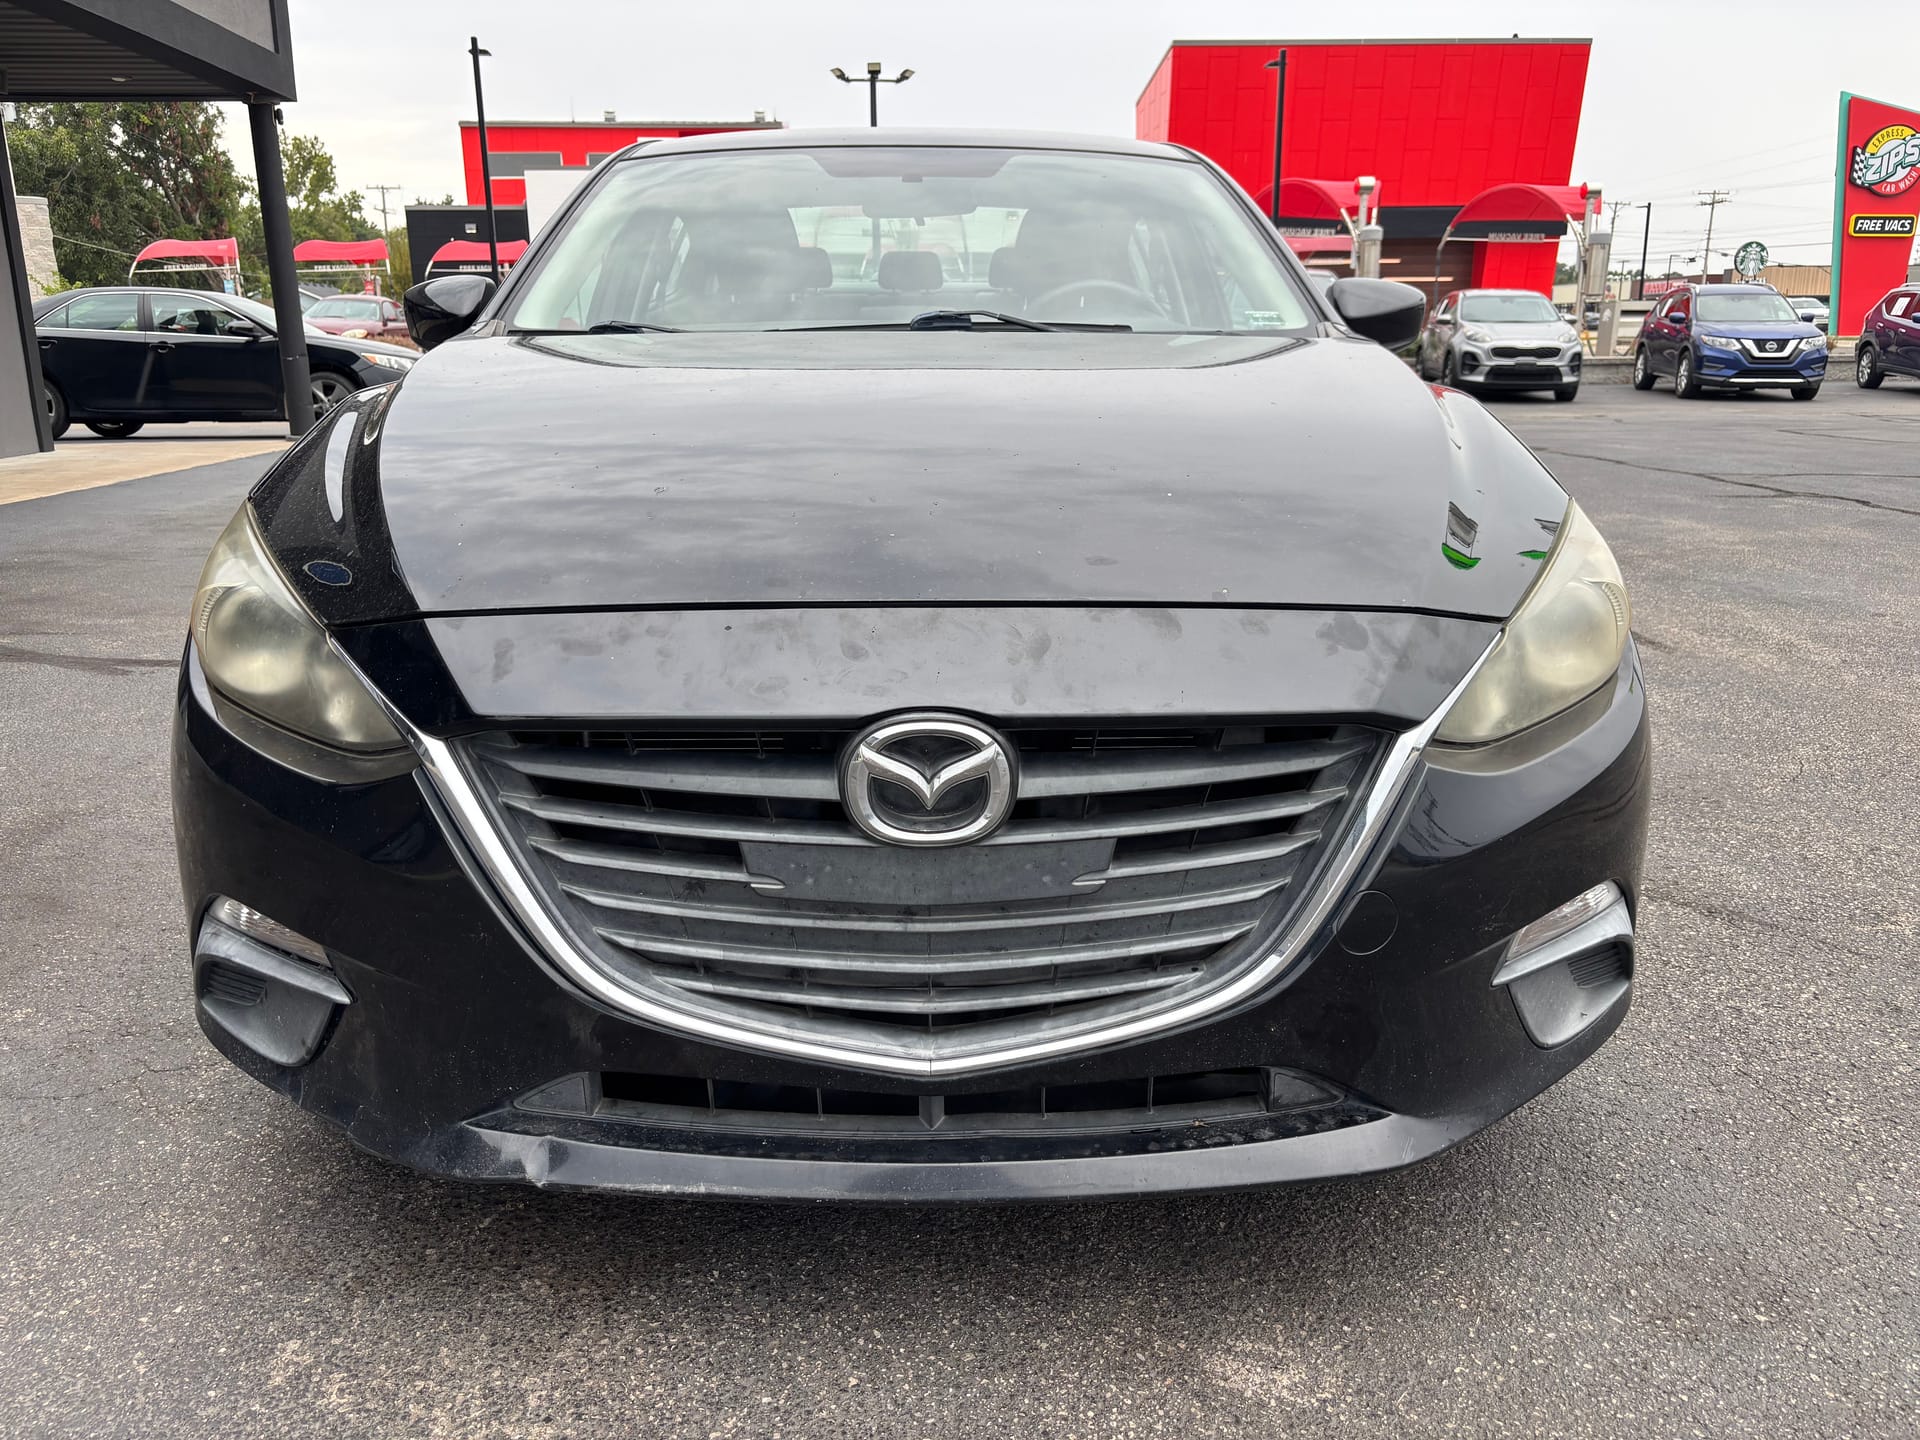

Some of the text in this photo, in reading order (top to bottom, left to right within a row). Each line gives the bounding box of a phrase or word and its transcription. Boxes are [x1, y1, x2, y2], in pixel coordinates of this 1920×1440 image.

[1872, 128, 1905, 148] EXPRESS
[1865, 137, 1920, 181] ZIPS
[1881, 171, 1918, 193] CAR WASH
[1855, 219, 1912, 231] FREE VACS
